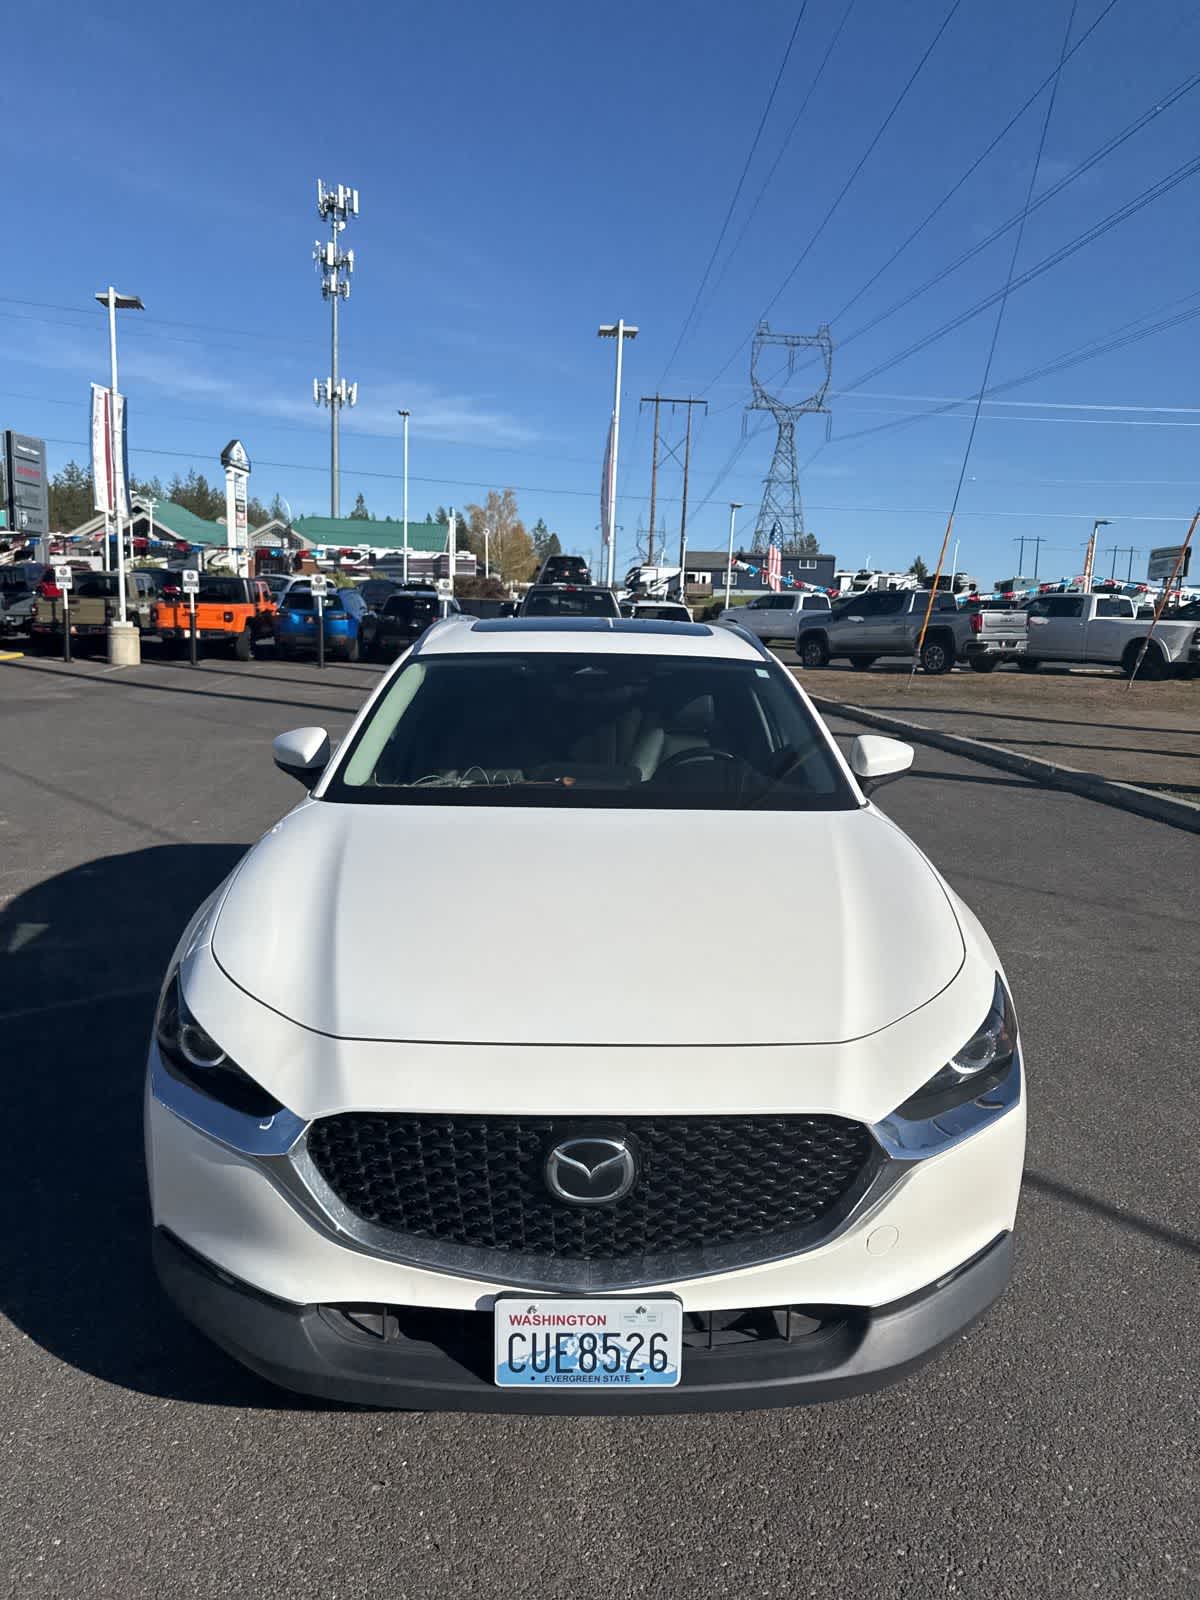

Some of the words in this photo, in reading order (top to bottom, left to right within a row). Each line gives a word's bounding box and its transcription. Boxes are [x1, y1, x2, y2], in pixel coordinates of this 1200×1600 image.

[509, 1314, 607, 1326] WASHINGTON
[508, 1332, 668, 1374] CUE8526
[544, 1375, 601, 1383] EVERGREEN
[602, 1375, 631, 1383] STATE
